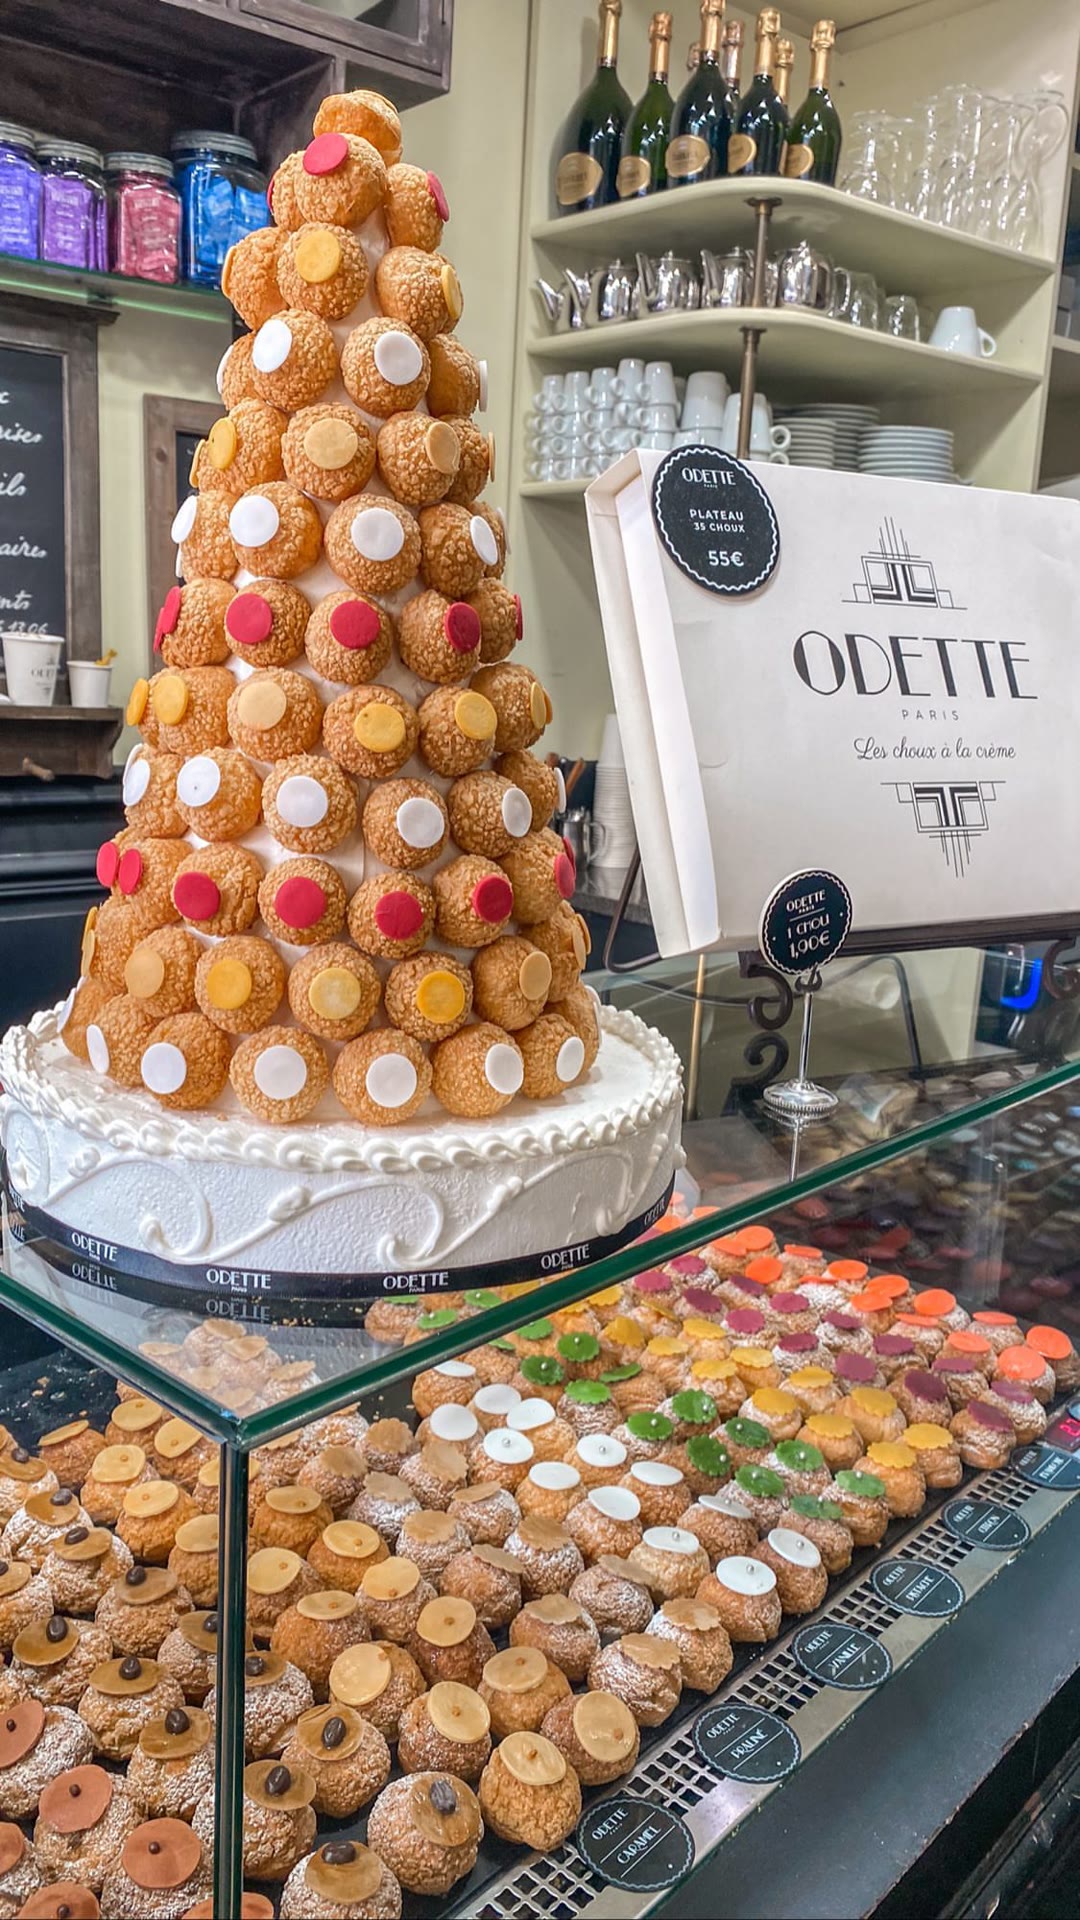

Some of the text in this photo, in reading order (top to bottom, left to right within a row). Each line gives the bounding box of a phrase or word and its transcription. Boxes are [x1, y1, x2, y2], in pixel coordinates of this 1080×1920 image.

[681, 467, 737, 486] ODETTE
[689, 508, 744, 521] PLATEAU
[693, 522, 745, 533] 35 CHOUX
[708, 550, 745, 567] 55€
[793, 630, 1039, 700] ODETTE
[901, 709, 960, 721] PARIS
[853, 736, 1017, 760] Les choux à la crème
[786, 889, 826, 912] ODETTE
[796, 913, 830, 935] CHOU
[789, 930, 830, 959] 1,90€
[71, 1231, 118, 1262] ODETTE
[541, 1243, 590, 1270] ODETTE
[206, 1268, 271, 1290] ODETTE
[383, 1271, 449, 1290] ODETTE
[882, 1564, 907, 1587] ODETTE
[804, 1629, 834, 1653] ODETTE
[828, 1642, 862, 1669] VANILLE
[706, 1712, 741, 1739] ODETTE
[730, 1727, 769, 1759] PRALINÉ
[591, 1807, 630, 1841] ODETTE
[616, 1825, 662, 1864] CARAMEL
